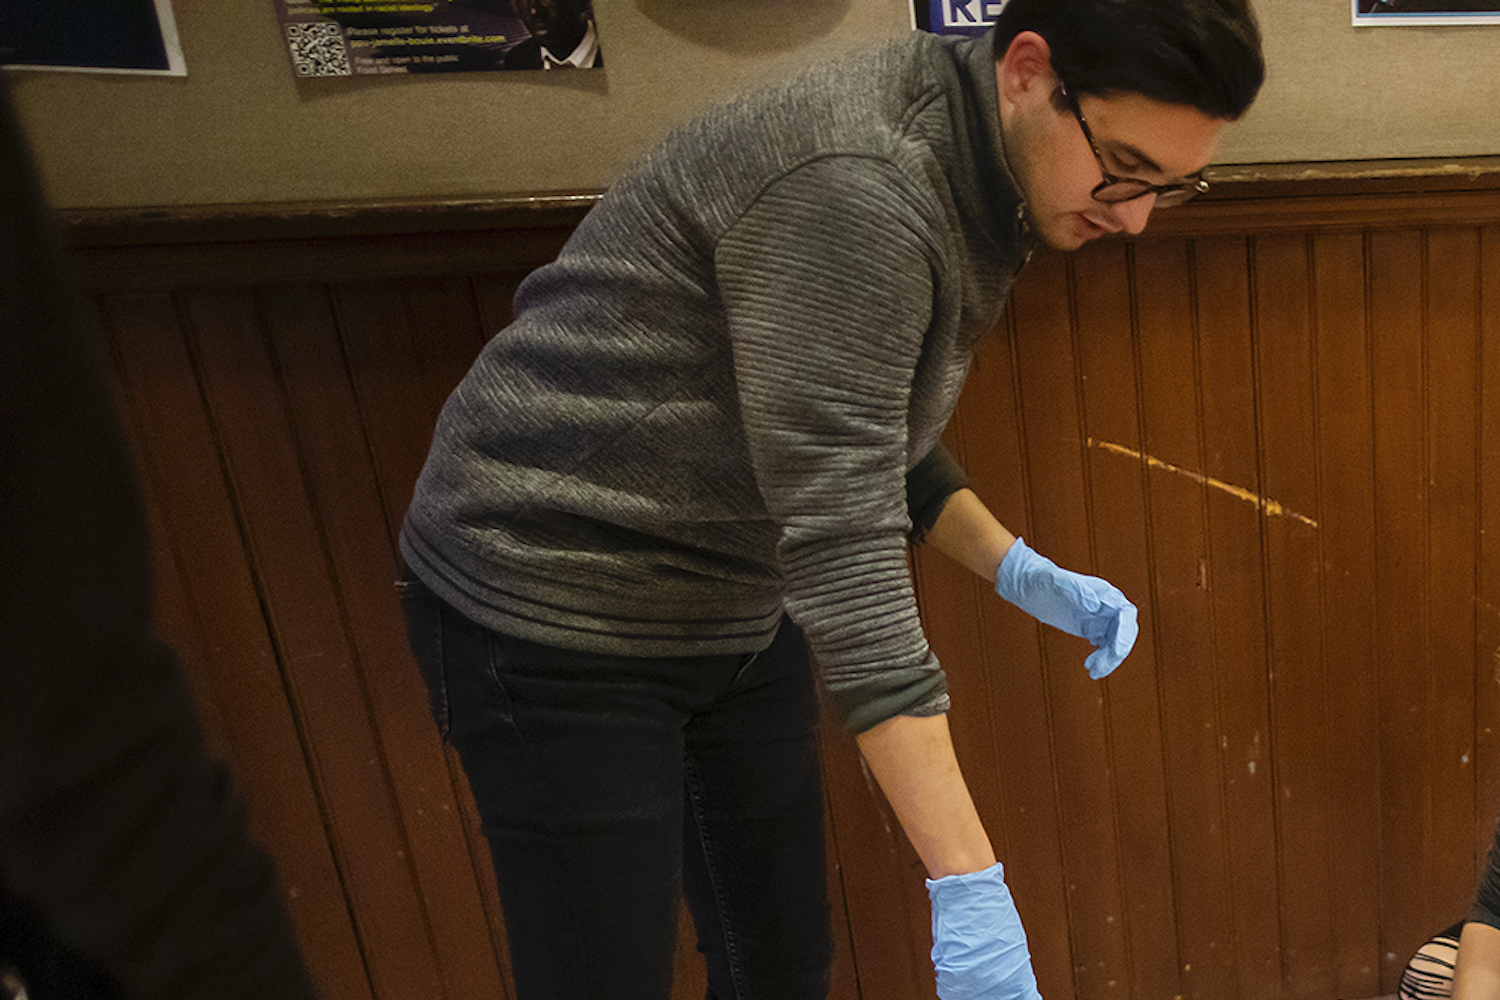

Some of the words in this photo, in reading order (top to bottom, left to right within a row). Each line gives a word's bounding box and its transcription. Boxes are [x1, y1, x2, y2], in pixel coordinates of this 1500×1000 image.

[347, 26, 378, 36] Please
[380, 26, 413, 37] register
[415, 25, 429, 34] for
[430, 24, 459, 34] tickets
[460, 24, 470, 33] at
[375, 57, 391, 66] and
[392, 56, 412, 67] open
[423, 54, 435, 64] the
